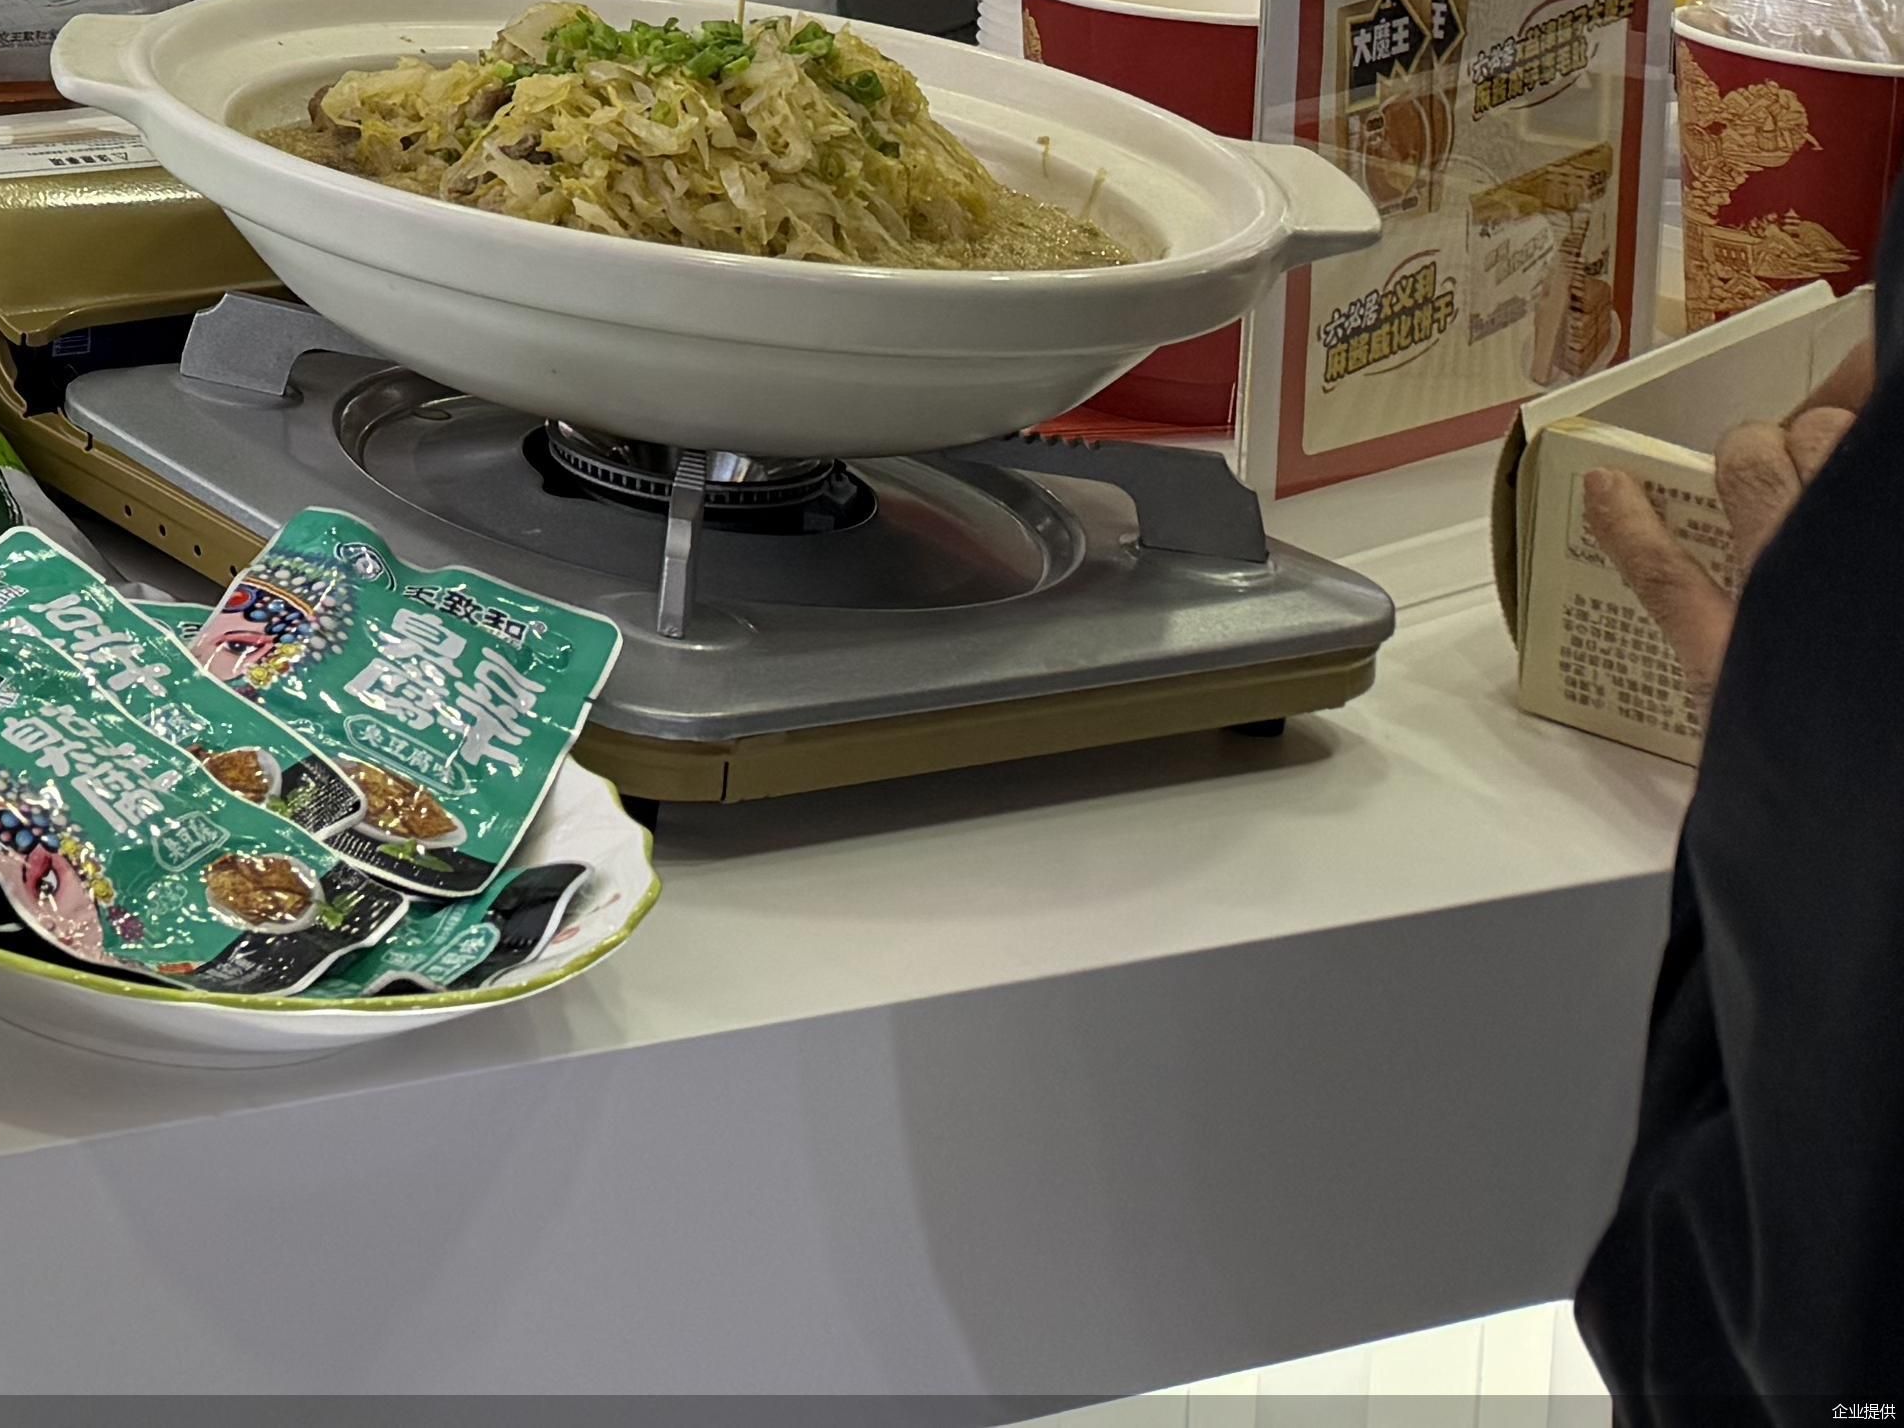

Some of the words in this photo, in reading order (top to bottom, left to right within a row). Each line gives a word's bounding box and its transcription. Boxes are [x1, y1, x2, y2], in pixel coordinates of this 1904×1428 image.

[1352, 16, 1412, 70] 大魔王
[402, 582, 530, 643] 王致和
